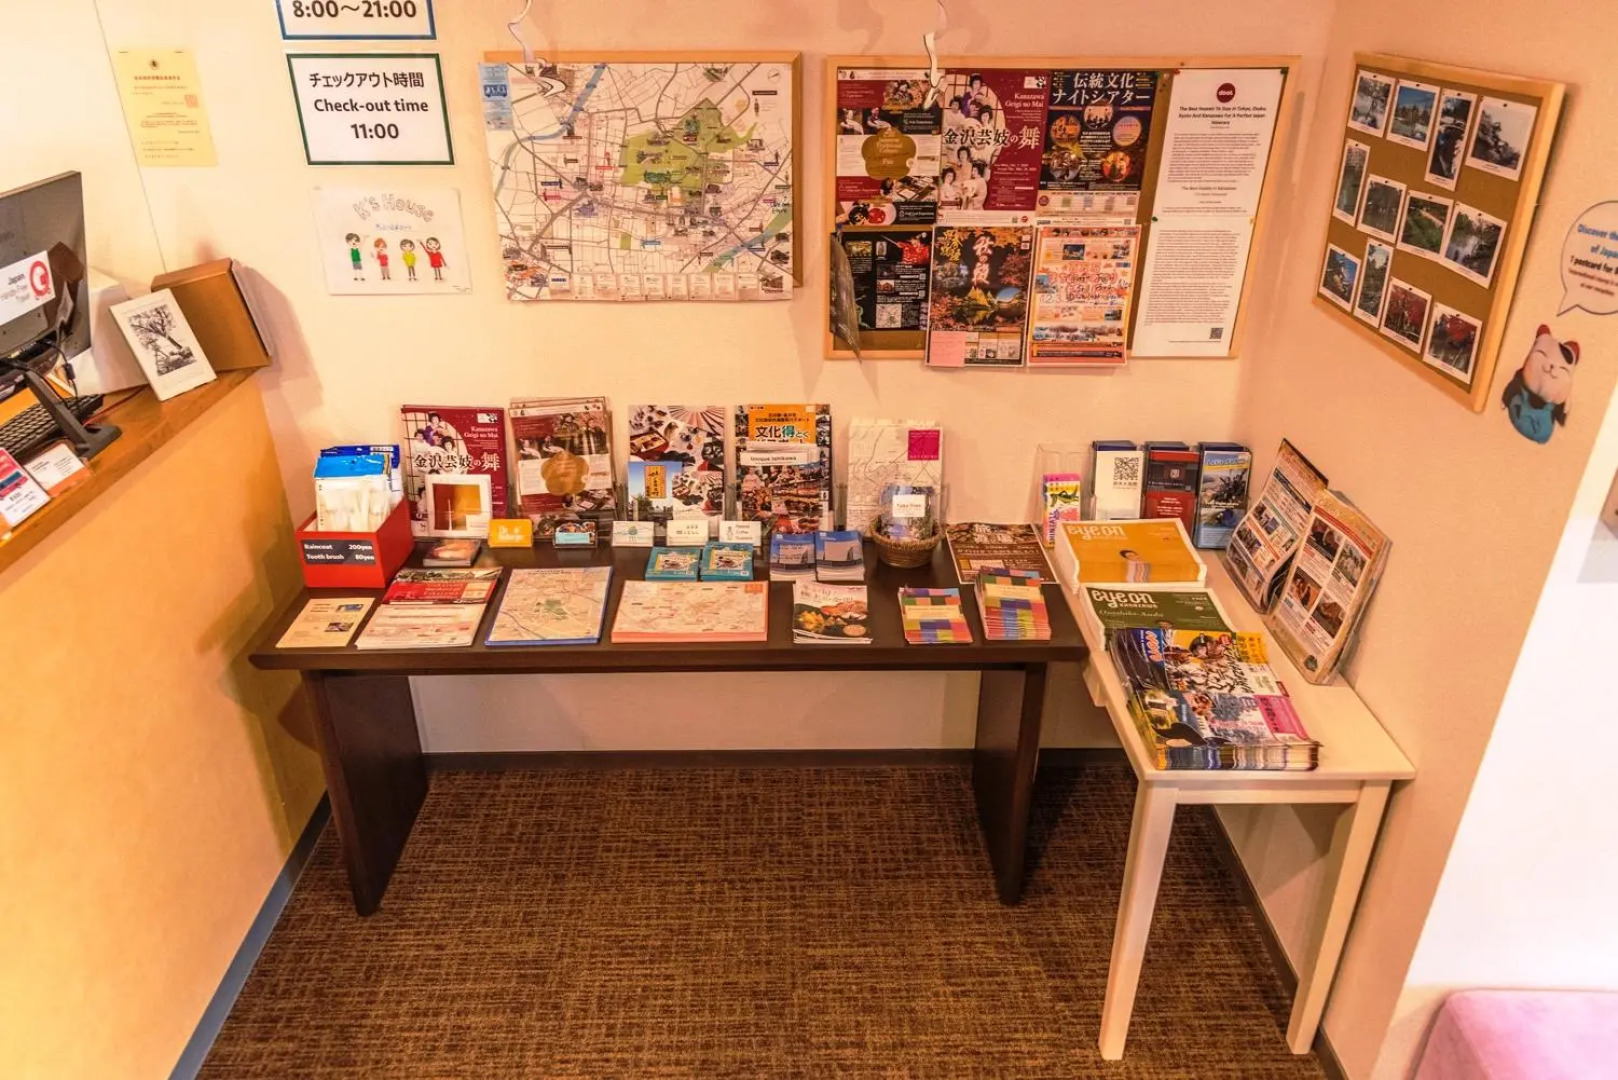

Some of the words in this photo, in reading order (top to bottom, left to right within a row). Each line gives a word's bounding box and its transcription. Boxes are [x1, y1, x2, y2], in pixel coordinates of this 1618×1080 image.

[310, 72, 424, 88] チェックアウト時間
[1074, 72, 1134, 88] 伝統文化
[1053, 89, 1150, 105] ナイトシアター
[314, 99, 391, 112] Check-out
[394, 99, 428, 111] time
[351, 123, 399, 138] 11:00
[944, 125, 1040, 149] 金沢芸妓の舞
[353, 195, 380, 221] K's
[1578, 224, 1608, 238] Discover
[1591, 244, 1600, 254] of
[1574, 258, 1602, 270] postcard
[1603, 263, 1613, 273] for
[414, 452, 500, 471] 金沢芸妓の舞
